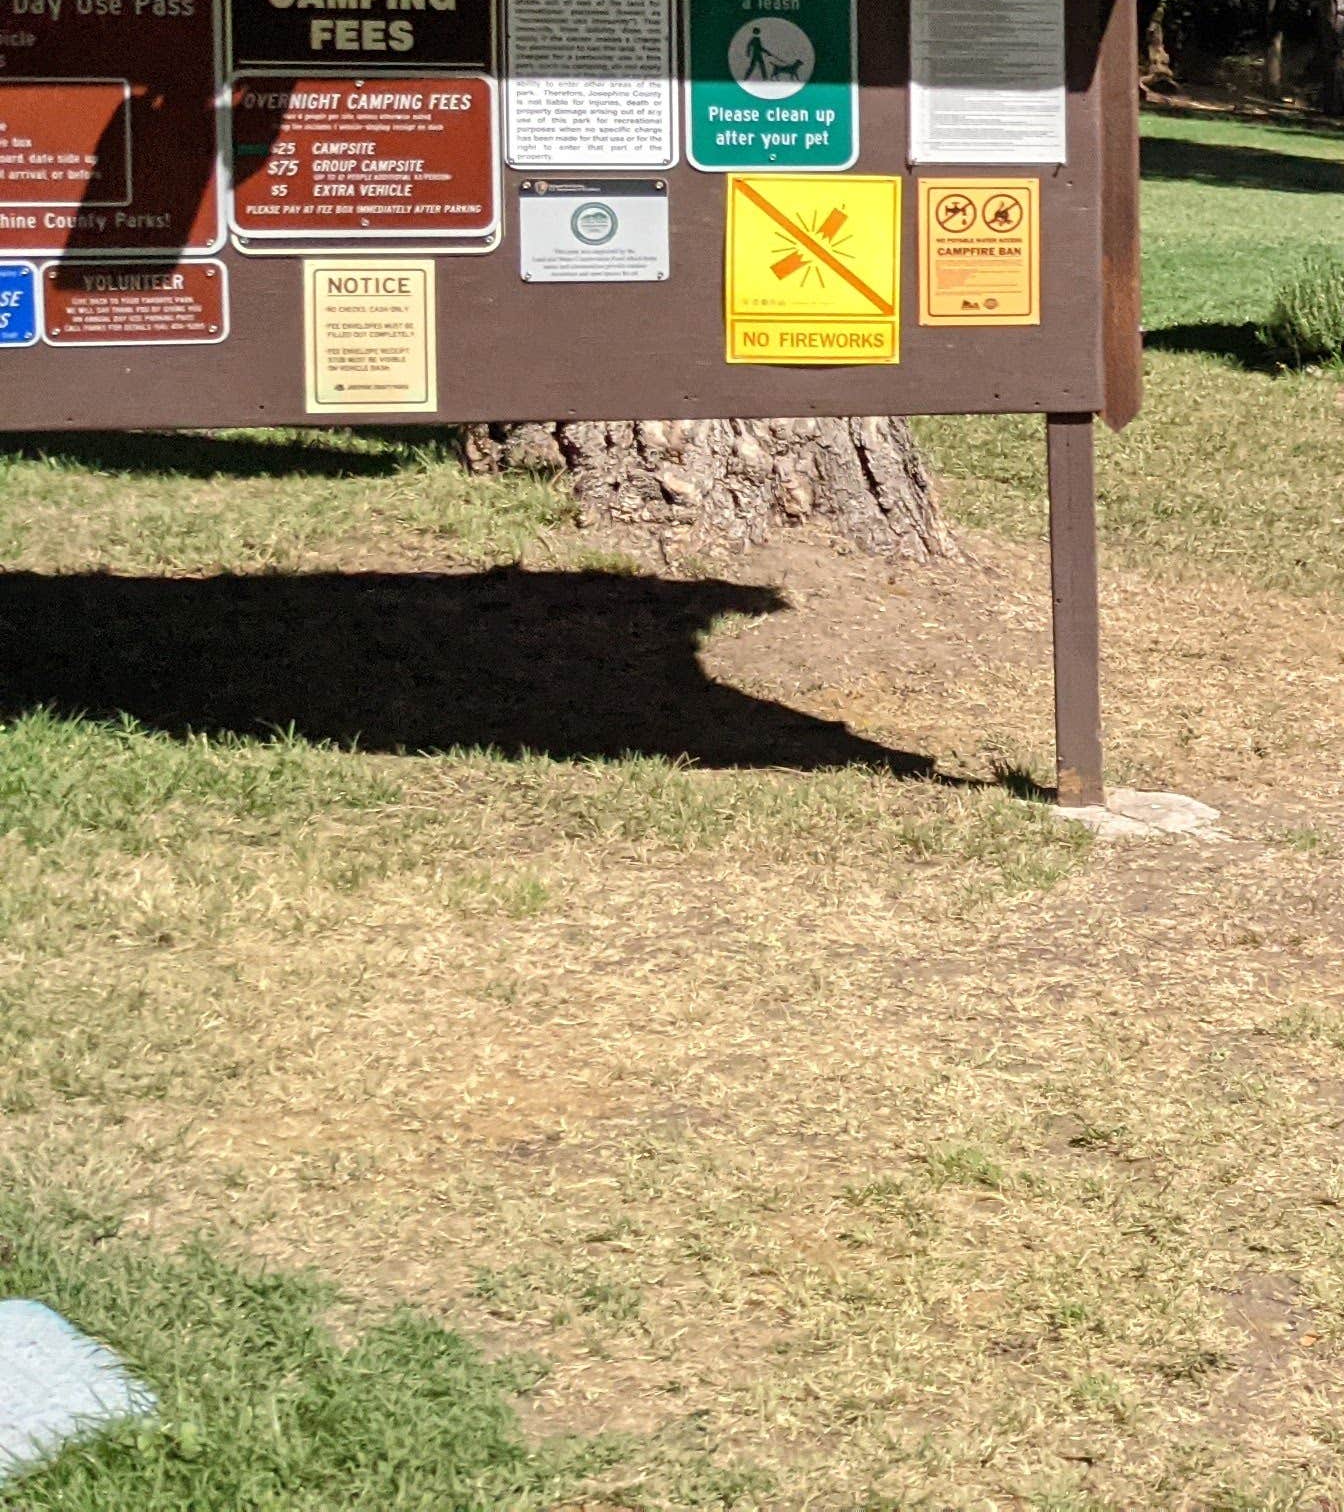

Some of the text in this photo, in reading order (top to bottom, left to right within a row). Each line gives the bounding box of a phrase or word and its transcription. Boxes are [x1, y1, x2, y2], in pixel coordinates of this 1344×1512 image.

[741, 0, 751, 10] a
[310, 20, 414, 51] FEES
[244, 93, 473, 110] OVERNIGHT CAMPING FEES
[709, 106, 835, 125] Please clean up
[716, 131, 829, 149] after your pet
[312, 142, 376, 155] CAMPSITE
[267, 160, 424, 176] $75 GROUP CAMPSITE
[313, 184, 355, 197] EXTRA
[360, 185, 413, 197] VEHICLE
[44, 213, 107, 232] County
[937, 247, 1022, 256] CAMPFIRE BAN
[83, 274, 184, 291] VOLUNTEER
[327, 277, 412, 293] NOTICE
[743, 332, 884, 348] NO FIREWORKS
